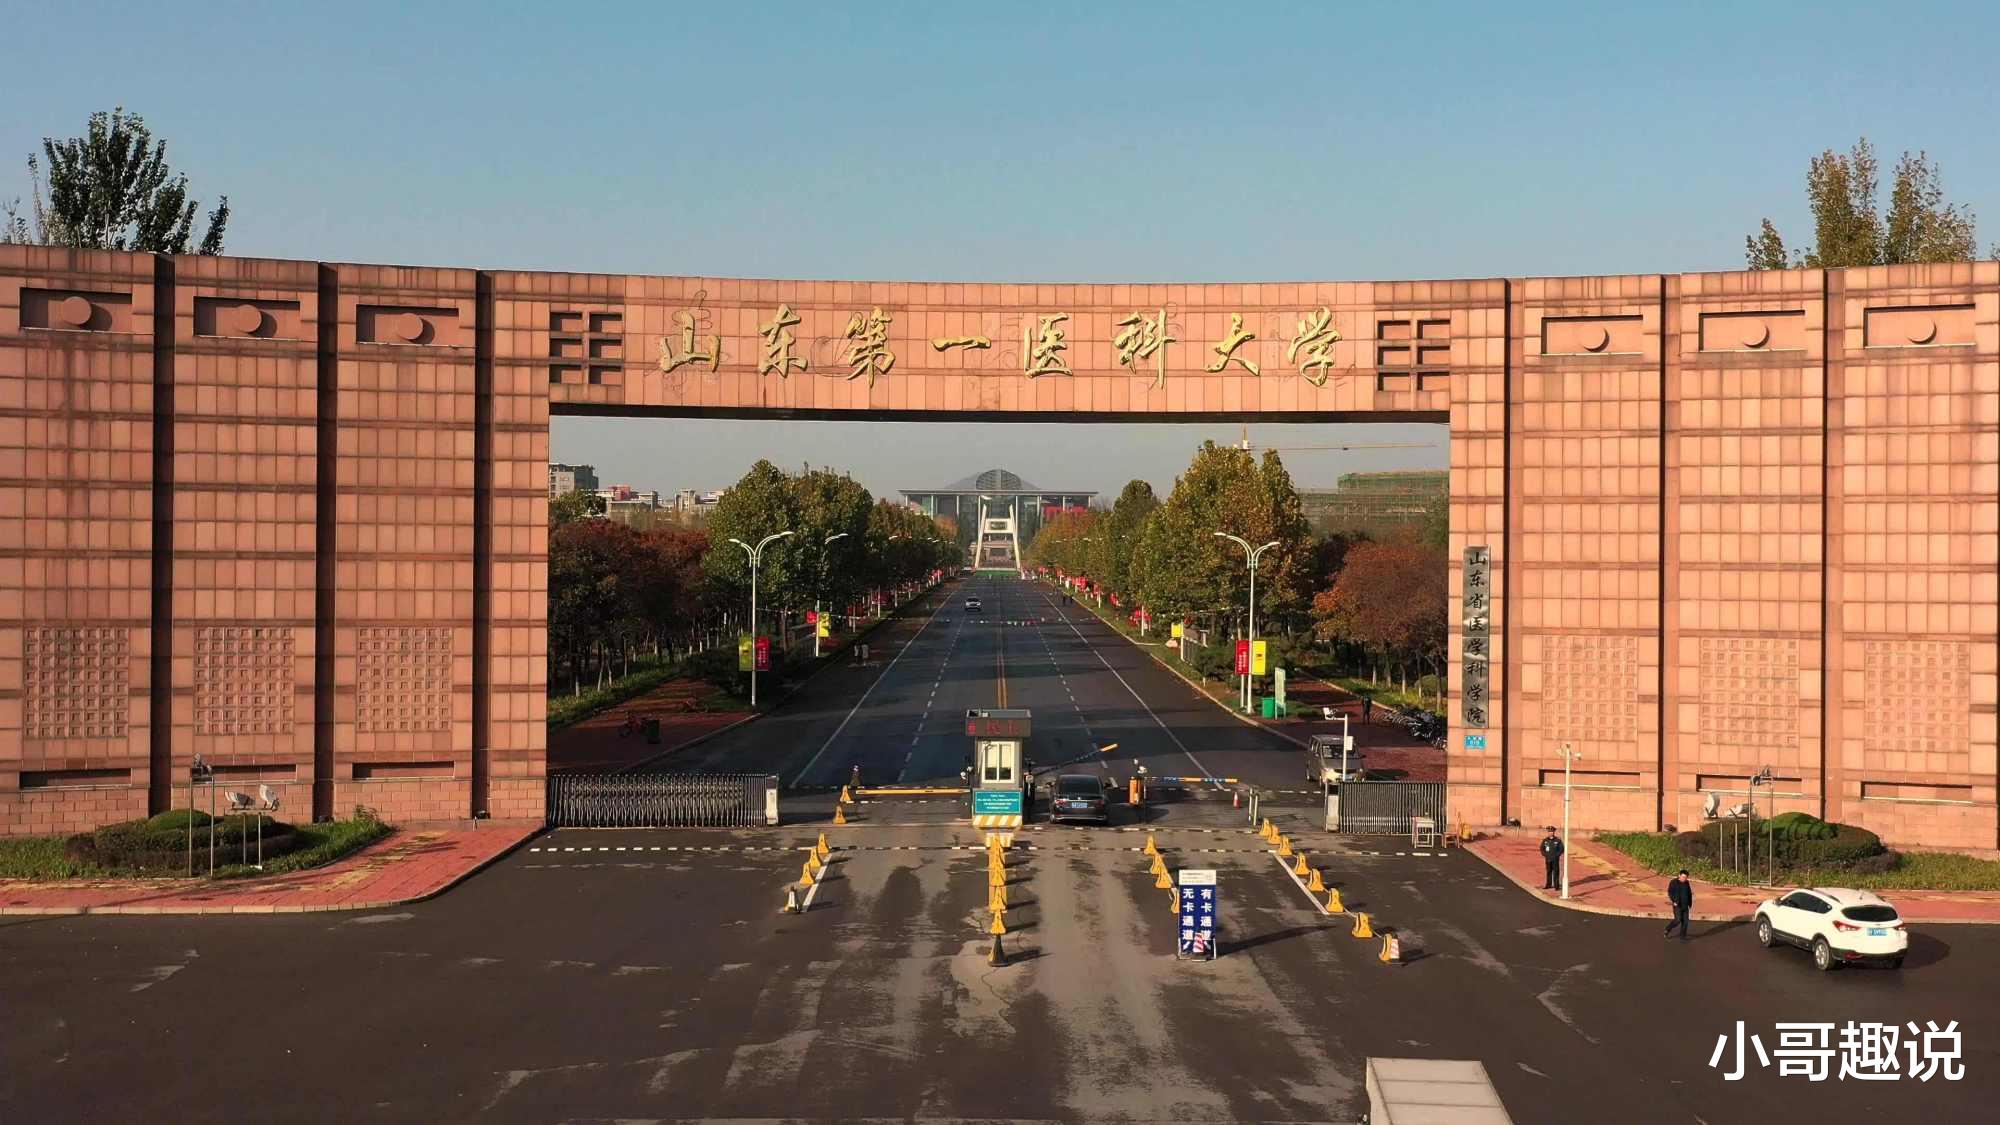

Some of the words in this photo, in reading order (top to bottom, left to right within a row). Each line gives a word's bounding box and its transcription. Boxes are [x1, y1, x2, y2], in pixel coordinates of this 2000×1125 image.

[658, 303, 1342, 389] 山东第一医科大学
[1466, 551, 1487, 724] 山东省医学科学院
